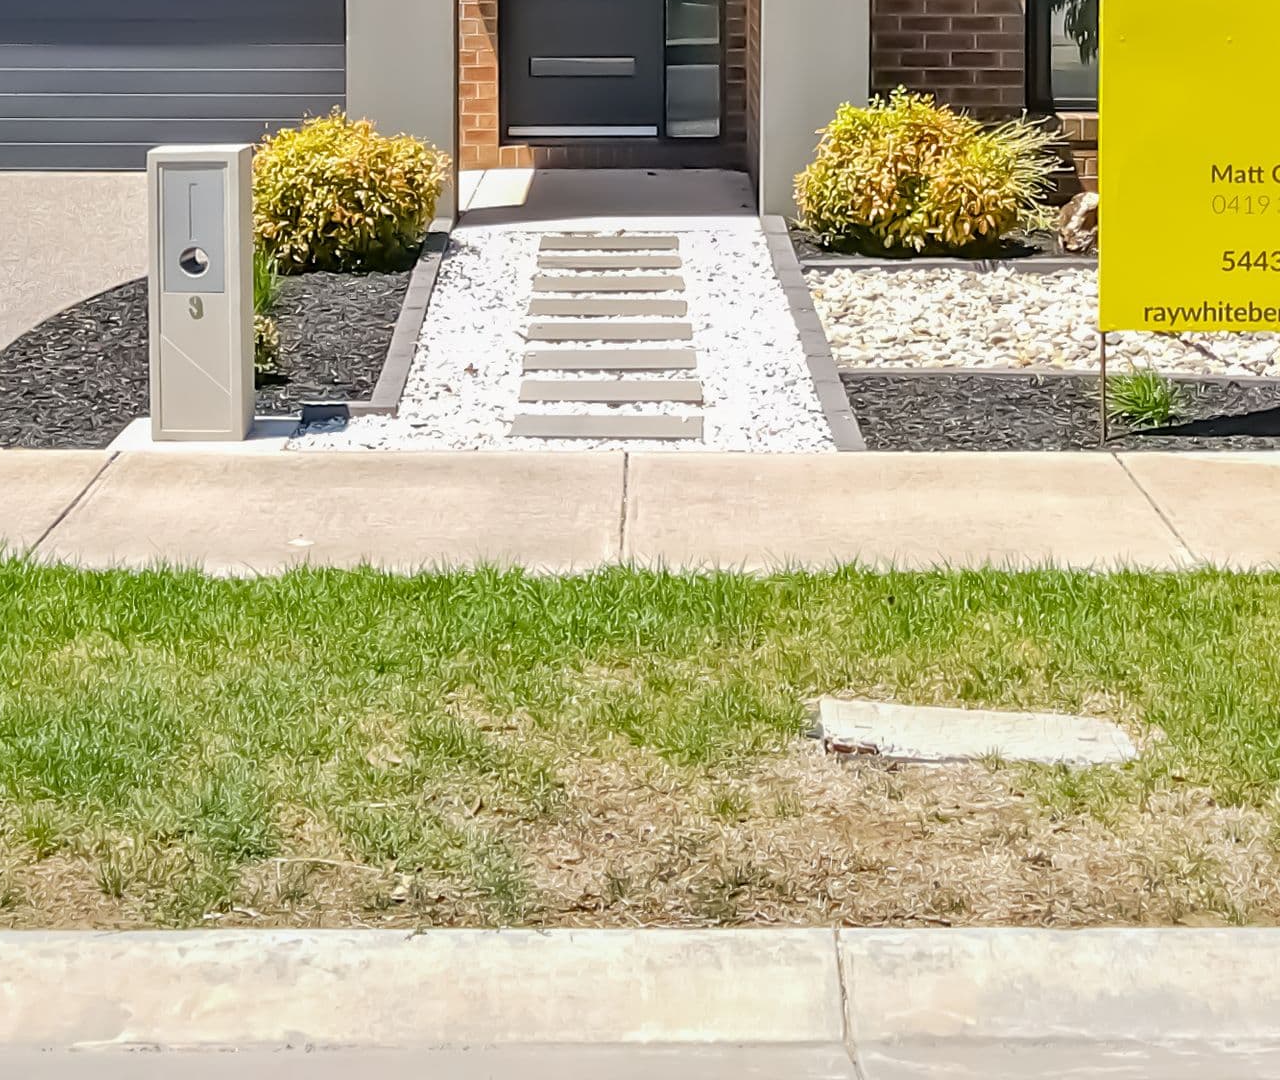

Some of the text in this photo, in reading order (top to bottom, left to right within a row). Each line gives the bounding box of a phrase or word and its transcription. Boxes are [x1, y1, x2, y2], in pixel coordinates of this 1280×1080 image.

[1211, 164, 1265, 184] Matt
[1211, 194, 1270, 215] 0419
[188, 295, 204, 320] 9
